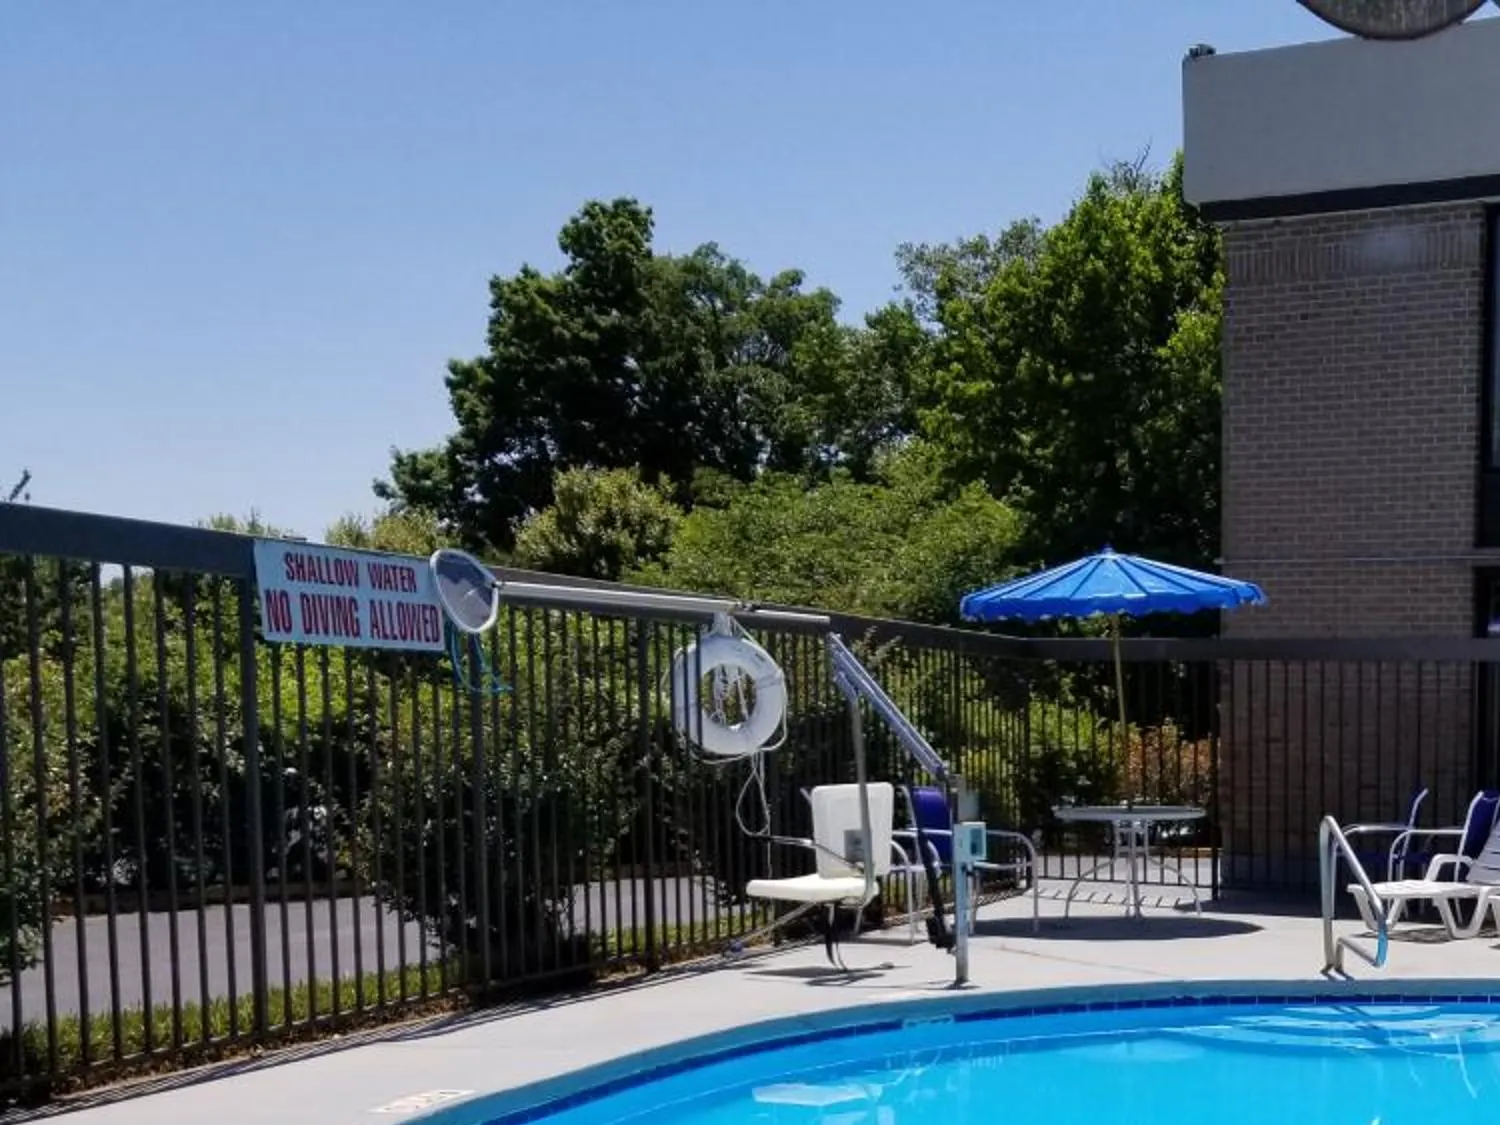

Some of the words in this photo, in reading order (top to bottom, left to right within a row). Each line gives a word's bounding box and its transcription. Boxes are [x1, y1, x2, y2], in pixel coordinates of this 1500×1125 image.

[284, 551, 360, 587] SHALLOW
[368, 561, 417, 592] WATER
[264, 588, 292, 634] NO
[300, 592, 360, 639] DIVING
[369, 599, 440, 643] ALLOWED
